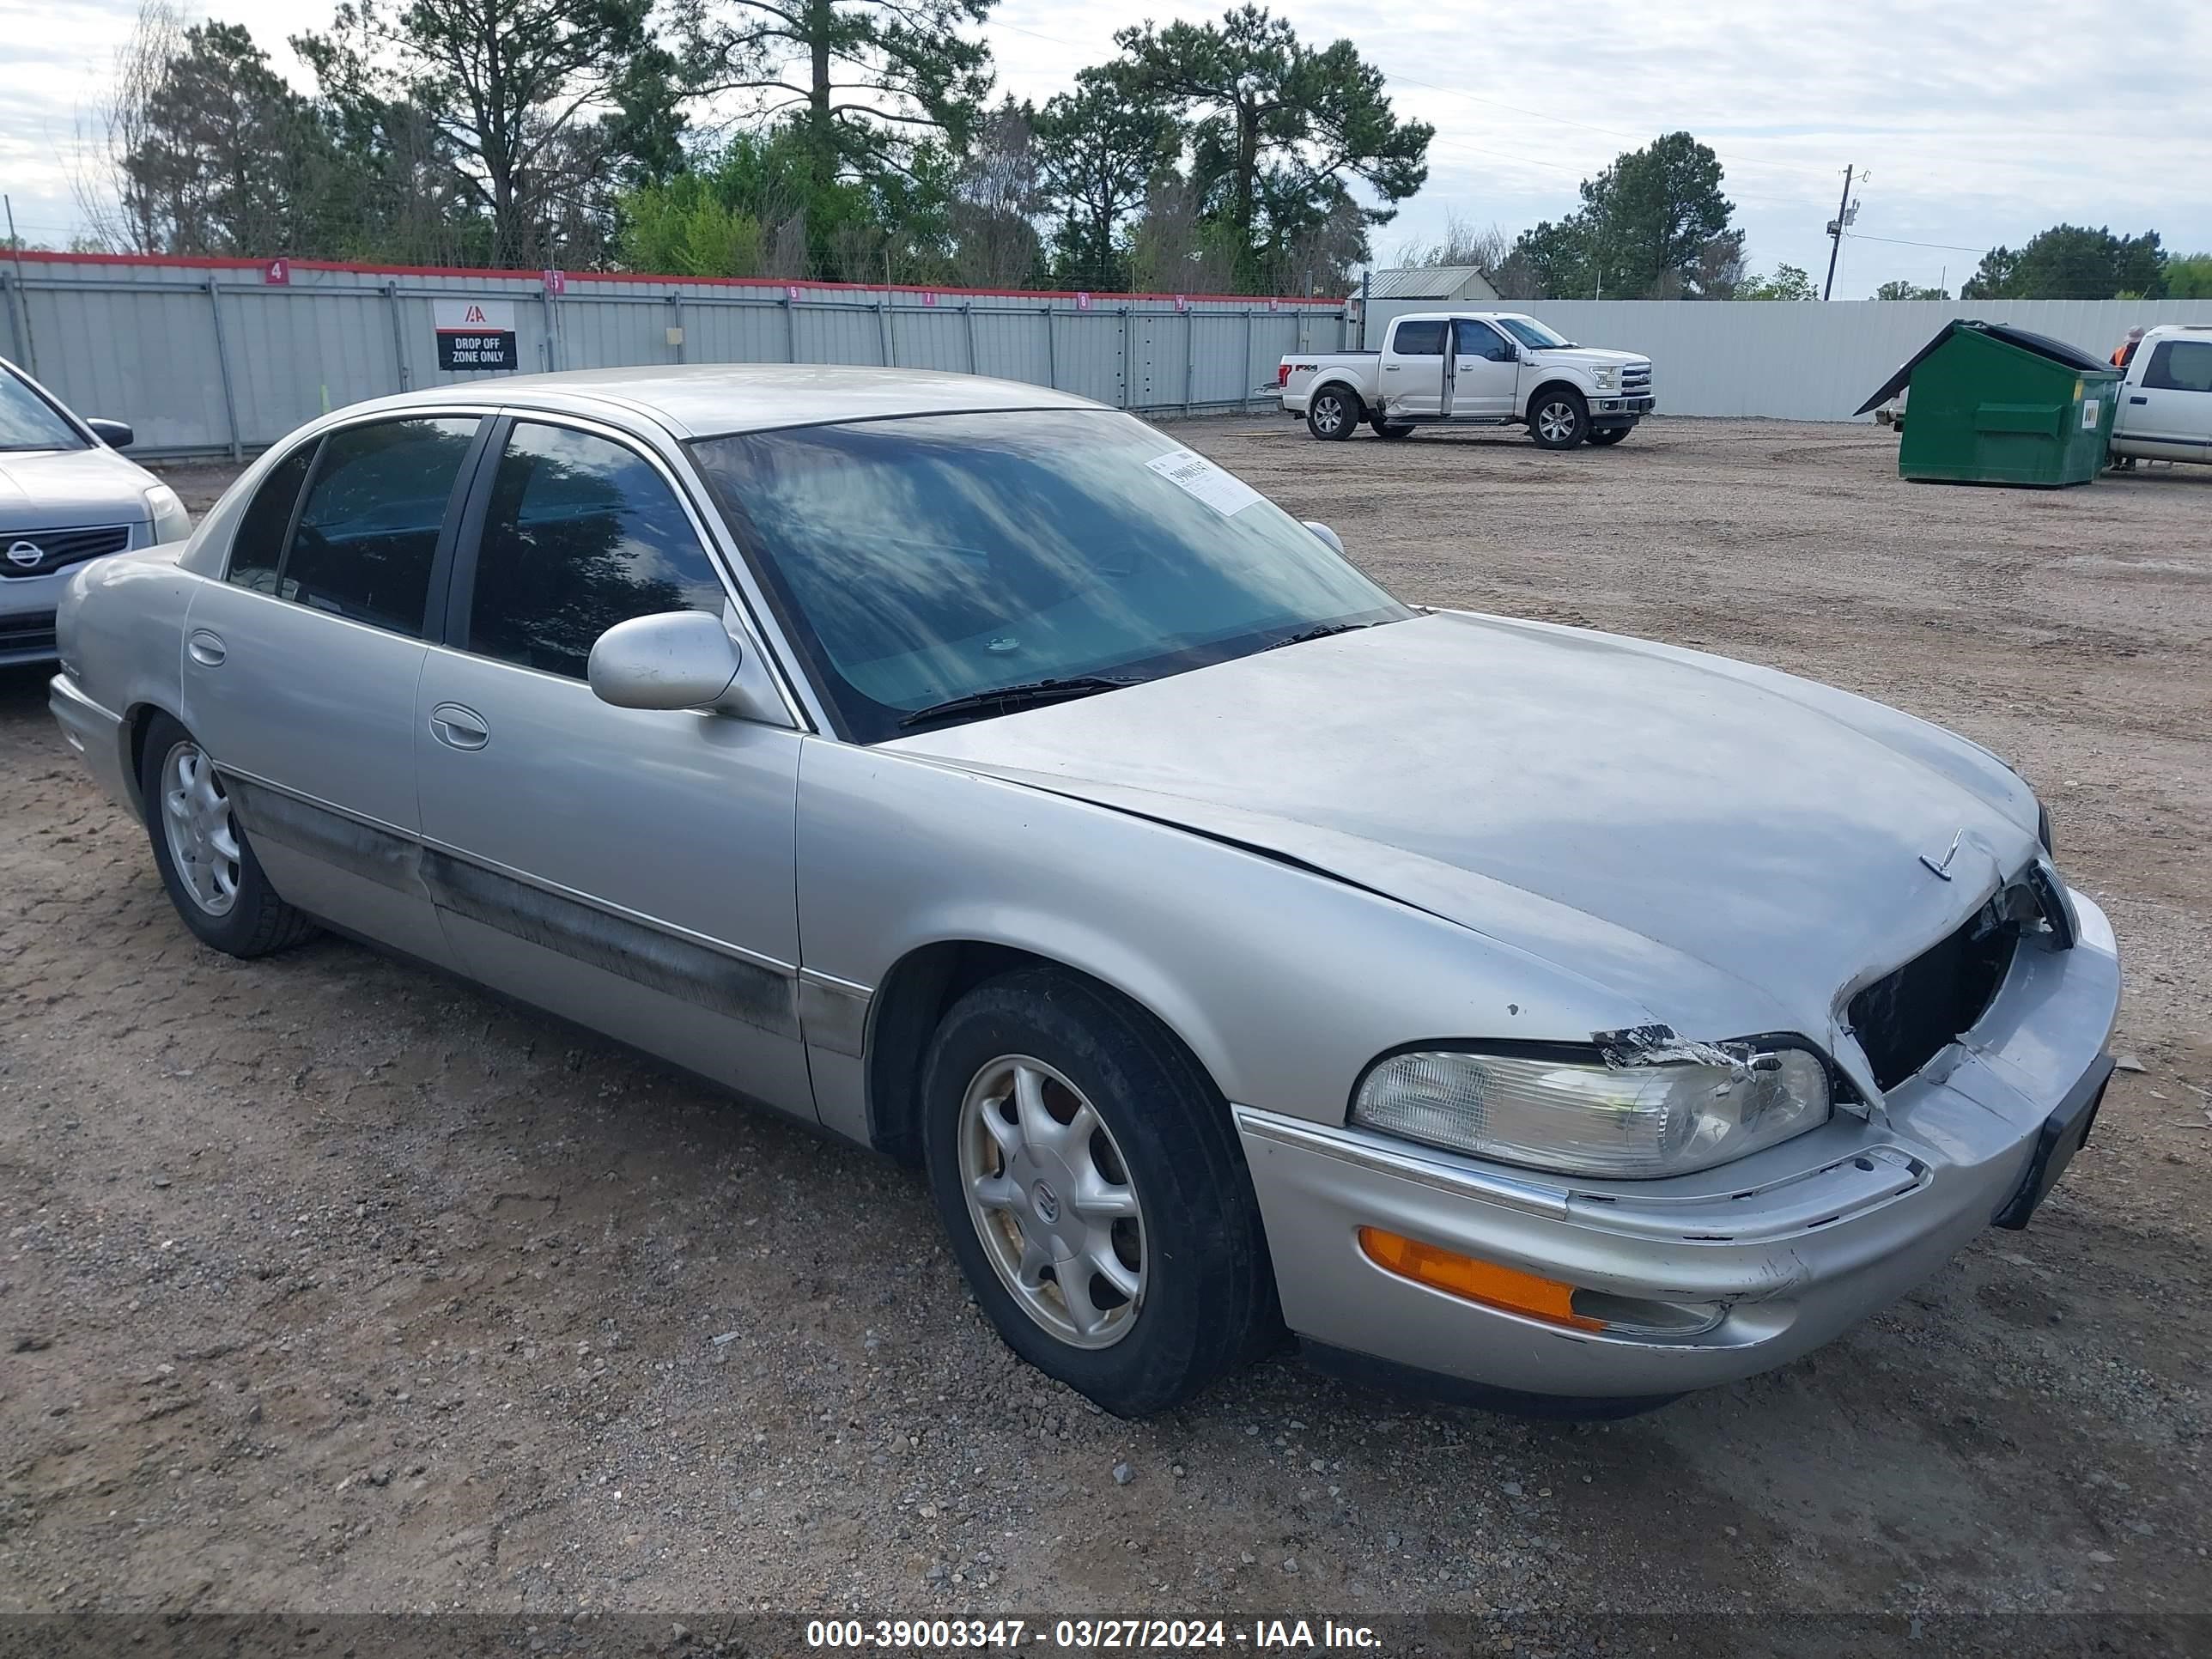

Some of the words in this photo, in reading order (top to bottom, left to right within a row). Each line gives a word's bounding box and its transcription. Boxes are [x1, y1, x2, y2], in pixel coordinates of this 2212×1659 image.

[271, 262, 282, 279] 4
[790, 286, 797, 298] 6
[926, 292, 931, 303] 7
[1081, 295, 1086, 307] 8
[1178, 297, 1182, 309] 9
[465, 306, 486, 322] IAA
[455, 337, 481, 349] DROP
[483, 337, 500, 349] OFF
[452, 351, 479, 362] ZONE
[480, 351, 504, 362] ONLY
